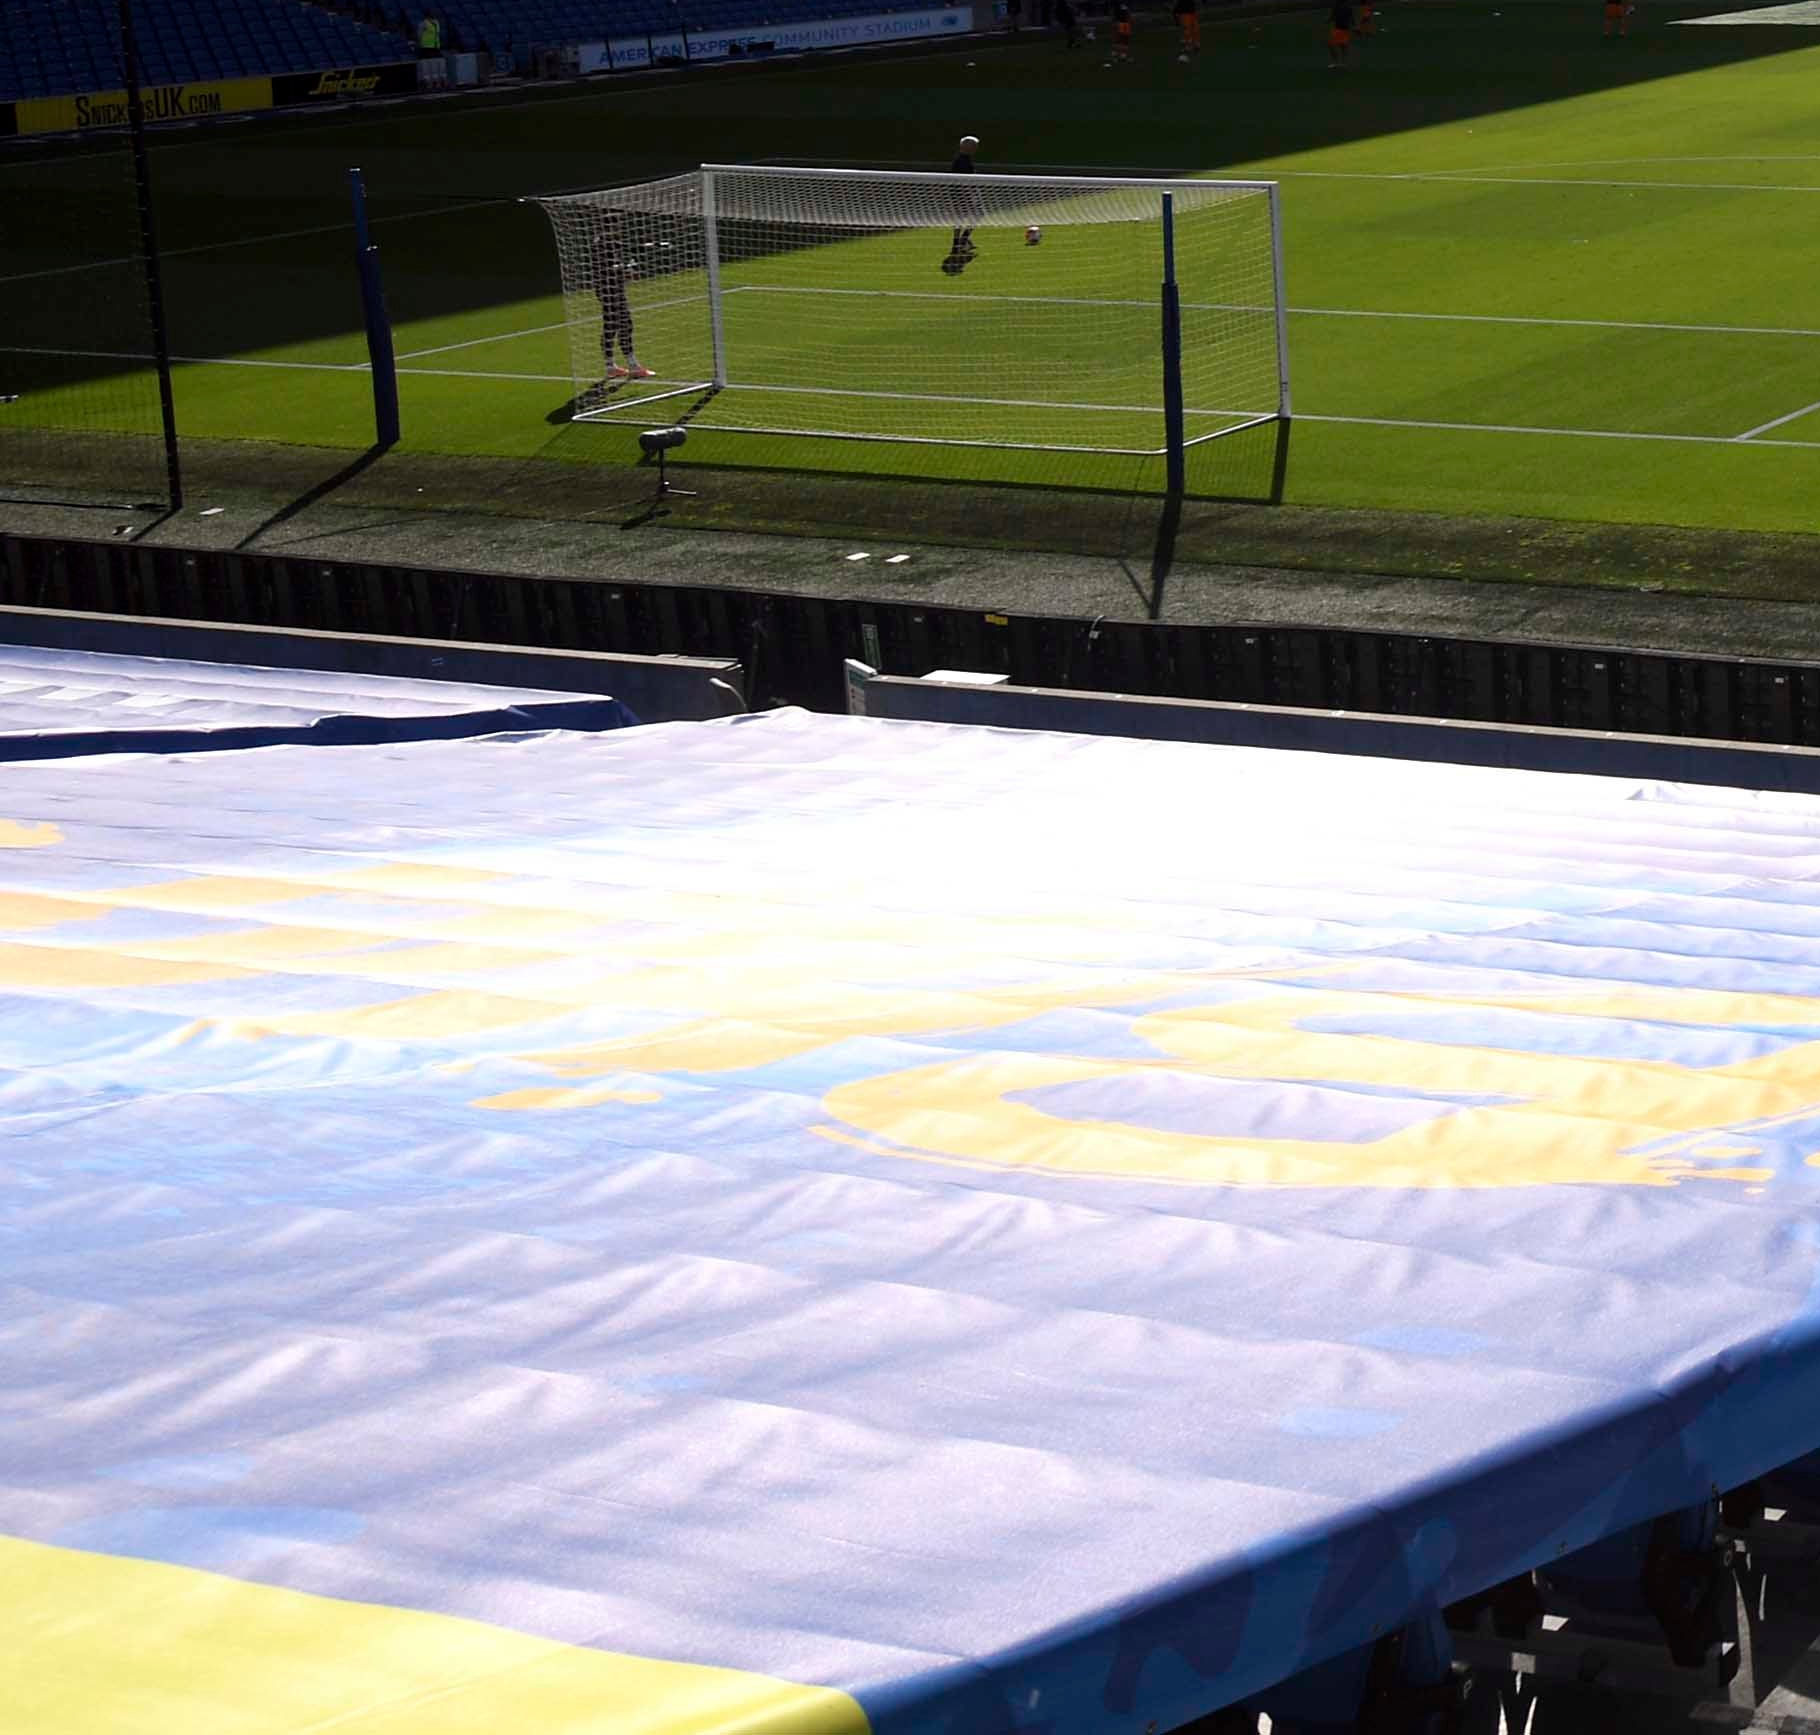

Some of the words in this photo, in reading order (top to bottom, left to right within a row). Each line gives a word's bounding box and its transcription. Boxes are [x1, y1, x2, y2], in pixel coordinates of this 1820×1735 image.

[598, 44, 682, 64] AMERICAN
[687, 36, 758, 56] EXPRESS
[761, 24, 860, 49] COMMUNITY
[864, 17, 932, 35] STADIUM
